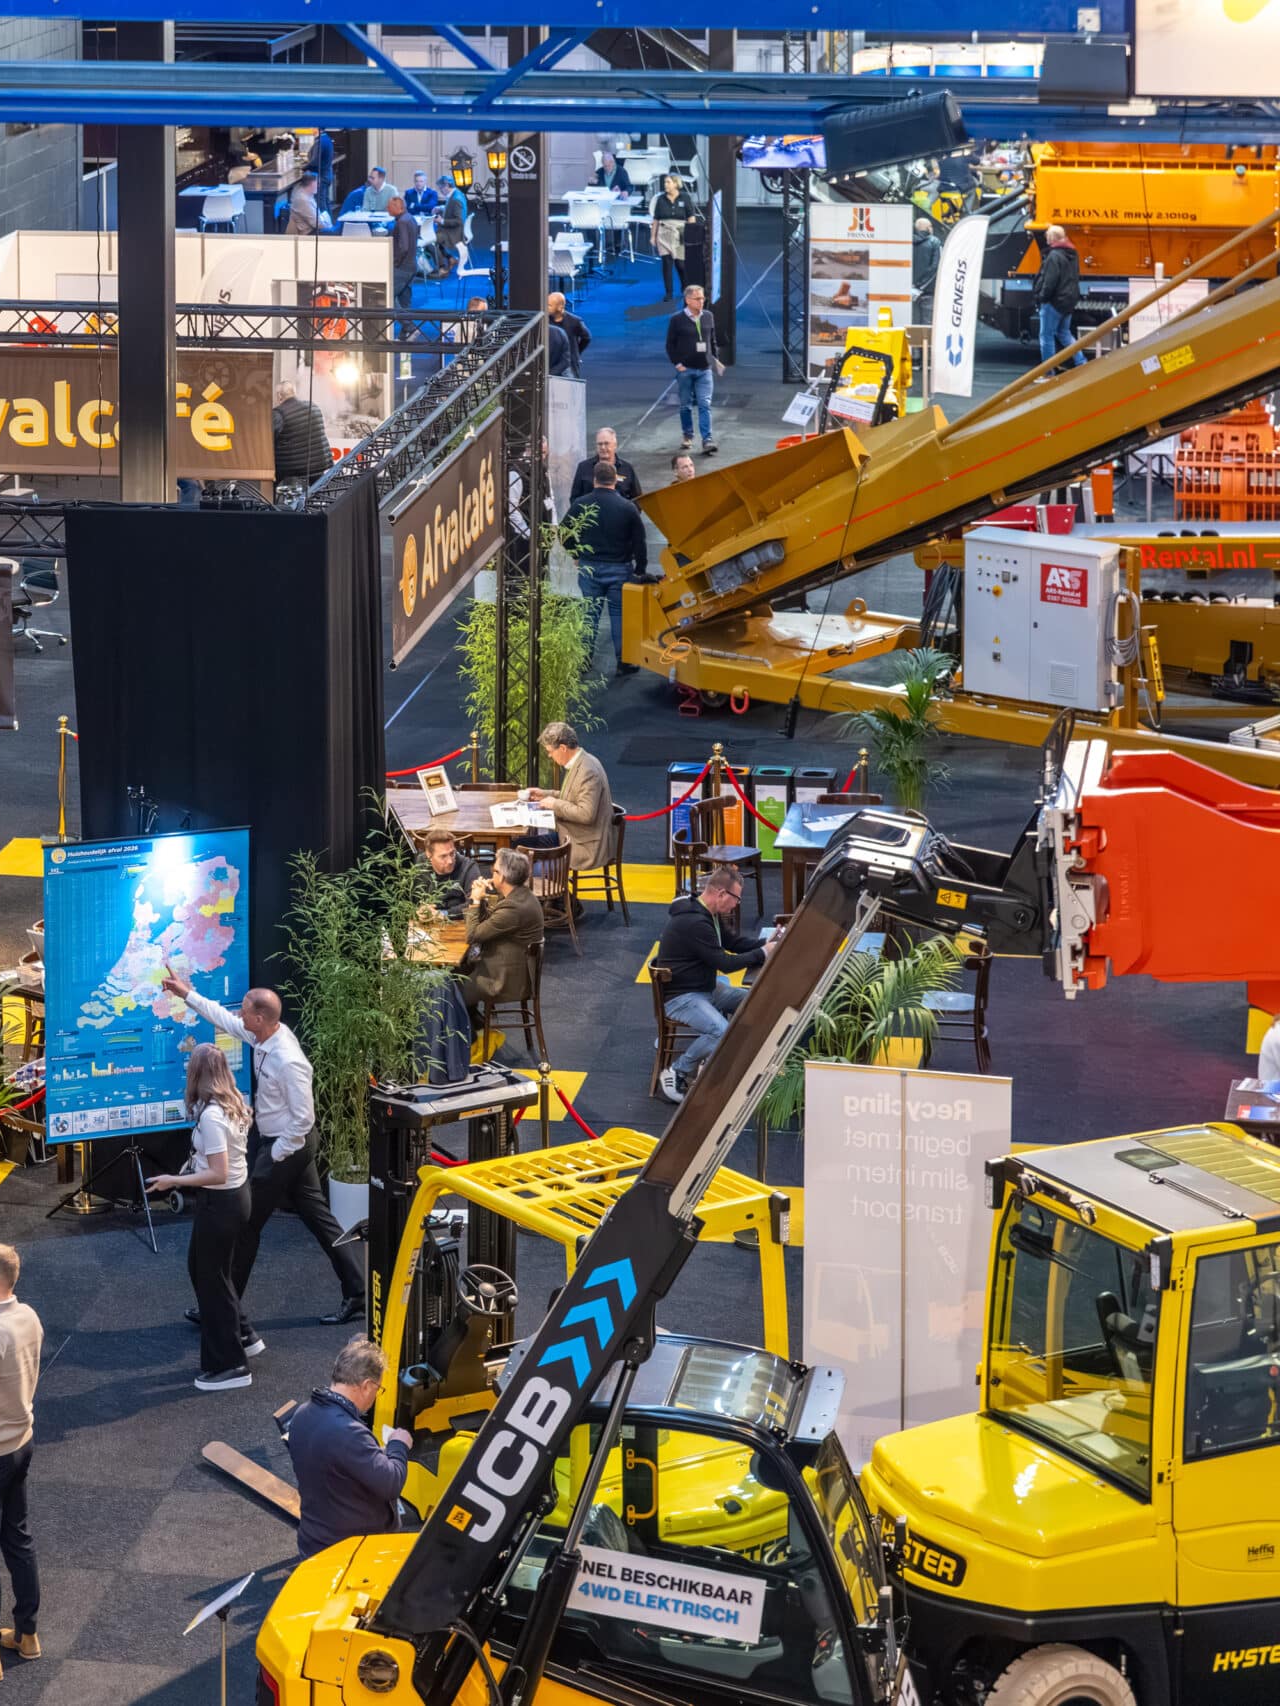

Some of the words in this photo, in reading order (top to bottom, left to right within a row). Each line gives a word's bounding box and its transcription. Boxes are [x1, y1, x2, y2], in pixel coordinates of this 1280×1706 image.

[1065, 208, 1119, 219] PRONAR
[951, 257, 968, 328] GENESIS
[422, 450, 495, 599] Afvalcafé
[1046, 567, 1082, 590] ARS
[372, 1270, 382, 1349] HYSTER
[461, 1376, 572, 1543] JCB
[578, 1560, 616, 1580] NEL
[621, 1567, 753, 1606] BESCHIKBAAR
[578, 1581, 621, 1601] 4WD
[623, 1590, 740, 1625] ELEKTRISCH
